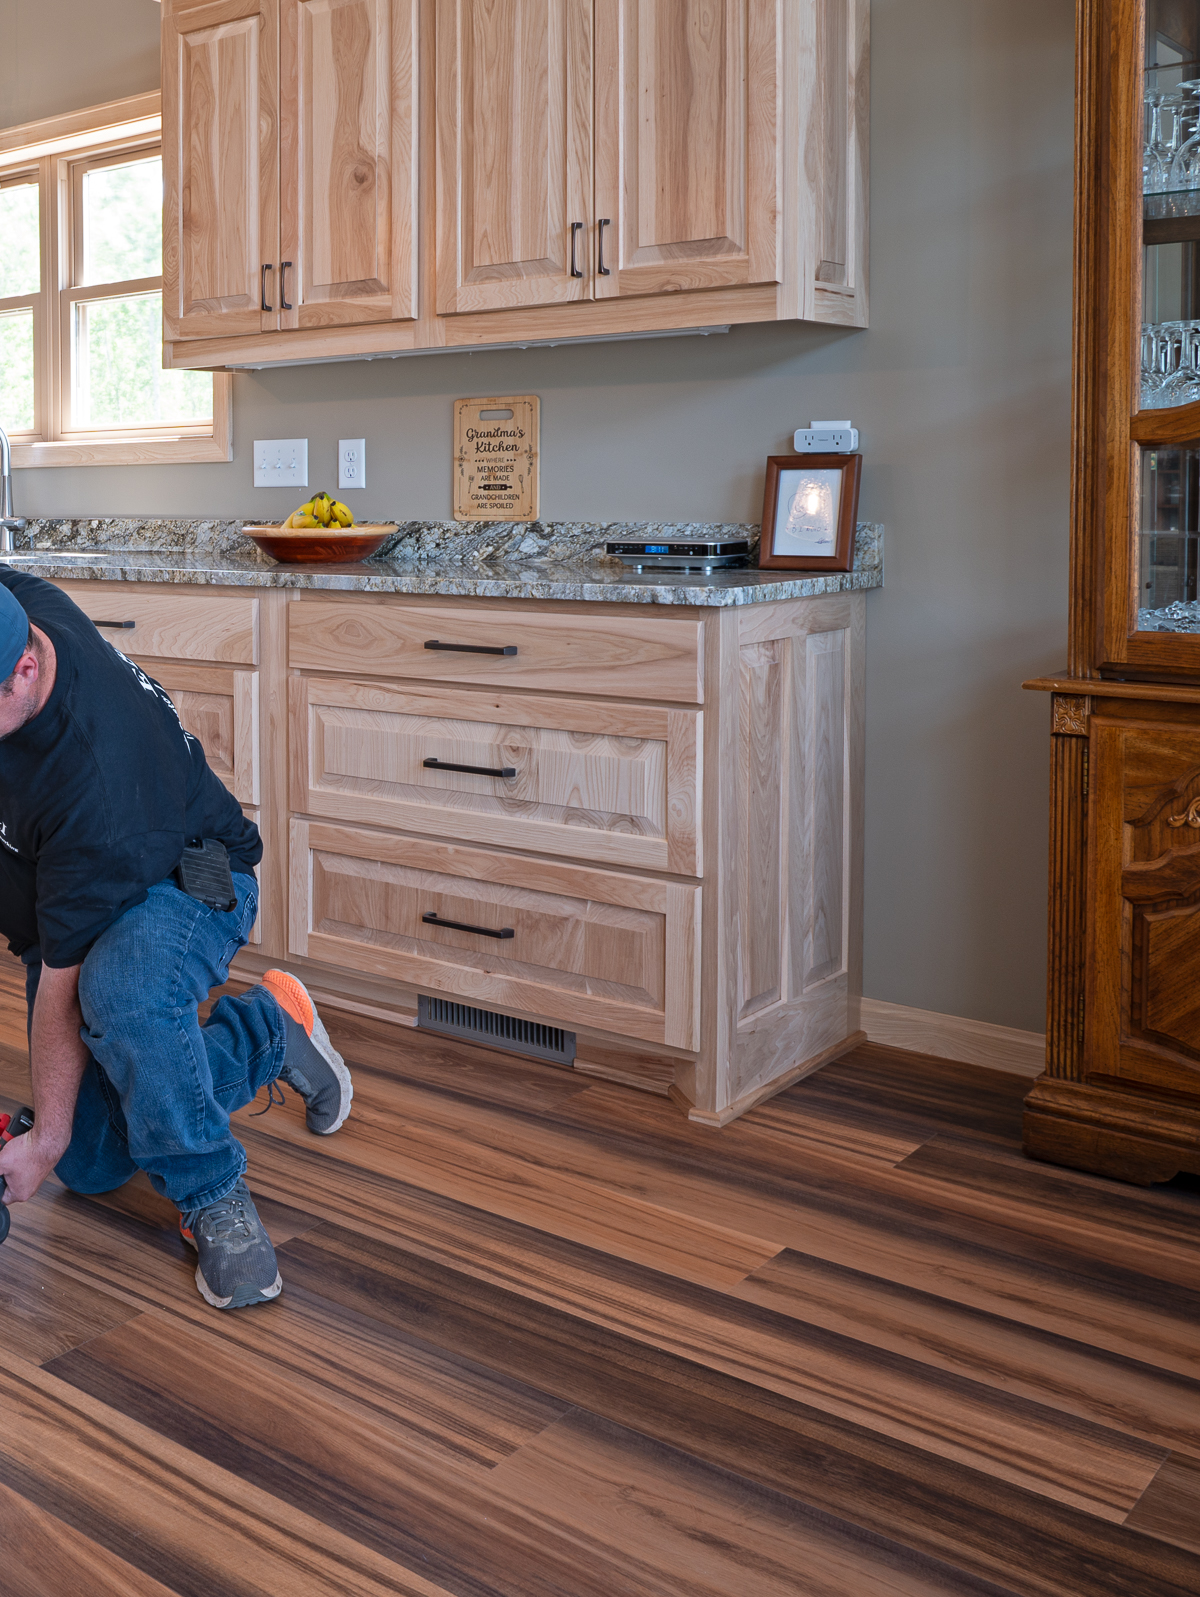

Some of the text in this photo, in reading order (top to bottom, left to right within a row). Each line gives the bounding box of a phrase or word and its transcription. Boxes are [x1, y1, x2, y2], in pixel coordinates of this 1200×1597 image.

[466, 426, 526, 442] Grandma's
[474, 440, 520, 454] Kitchen
[477, 465, 514, 473] MEMORIES
